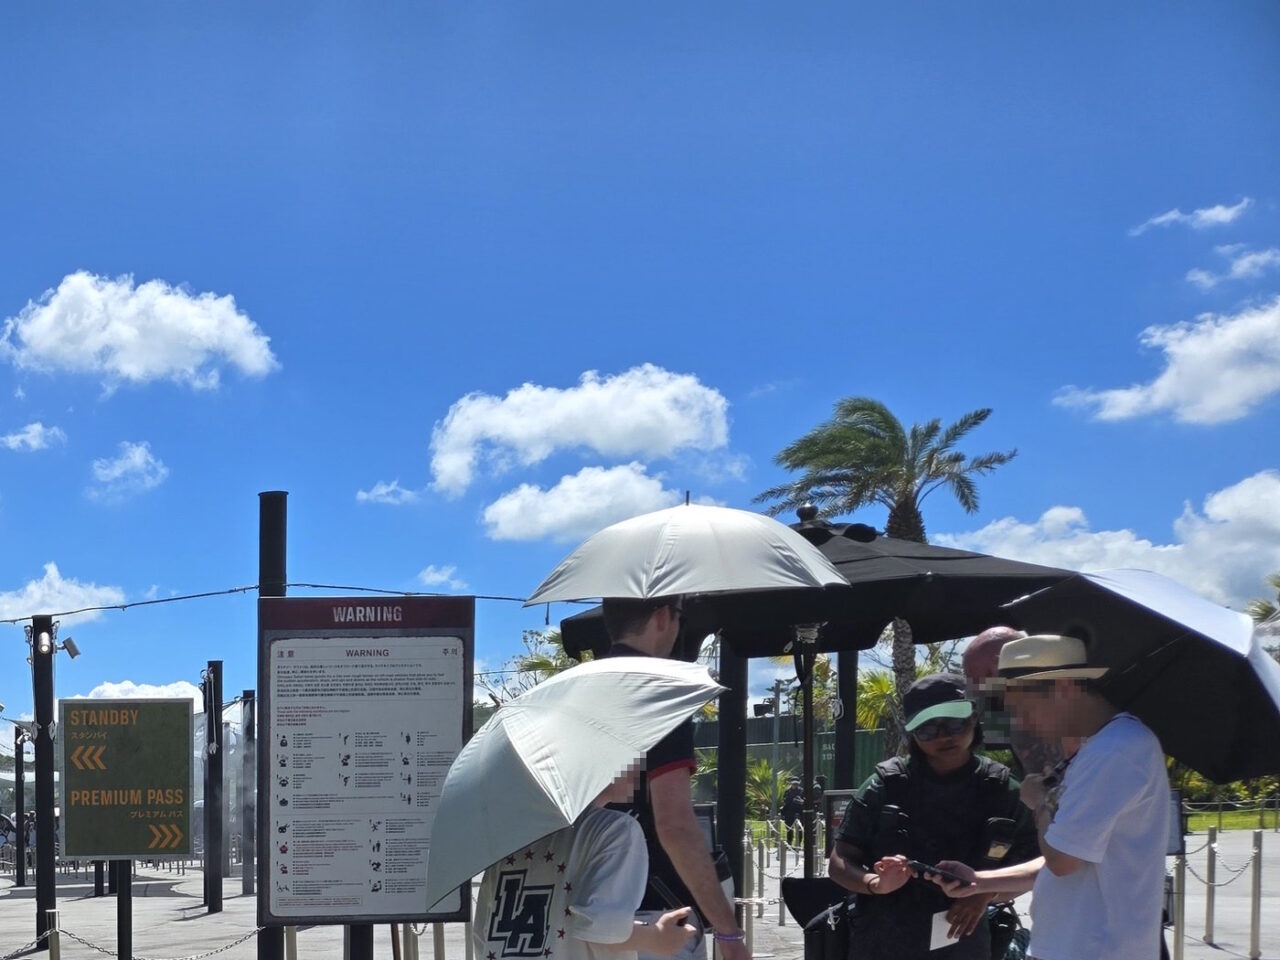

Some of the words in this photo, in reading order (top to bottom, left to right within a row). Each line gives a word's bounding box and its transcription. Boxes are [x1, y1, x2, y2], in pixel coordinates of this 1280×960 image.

[333, 606, 402, 622] WARNING
[345, 649, 389, 657] WARNING
[71, 710, 138, 726] STANDBY
[71, 732, 107, 740] スタンバイ
[71, 789, 142, 806] PREMIUM
[147, 789, 184, 804] PASS
